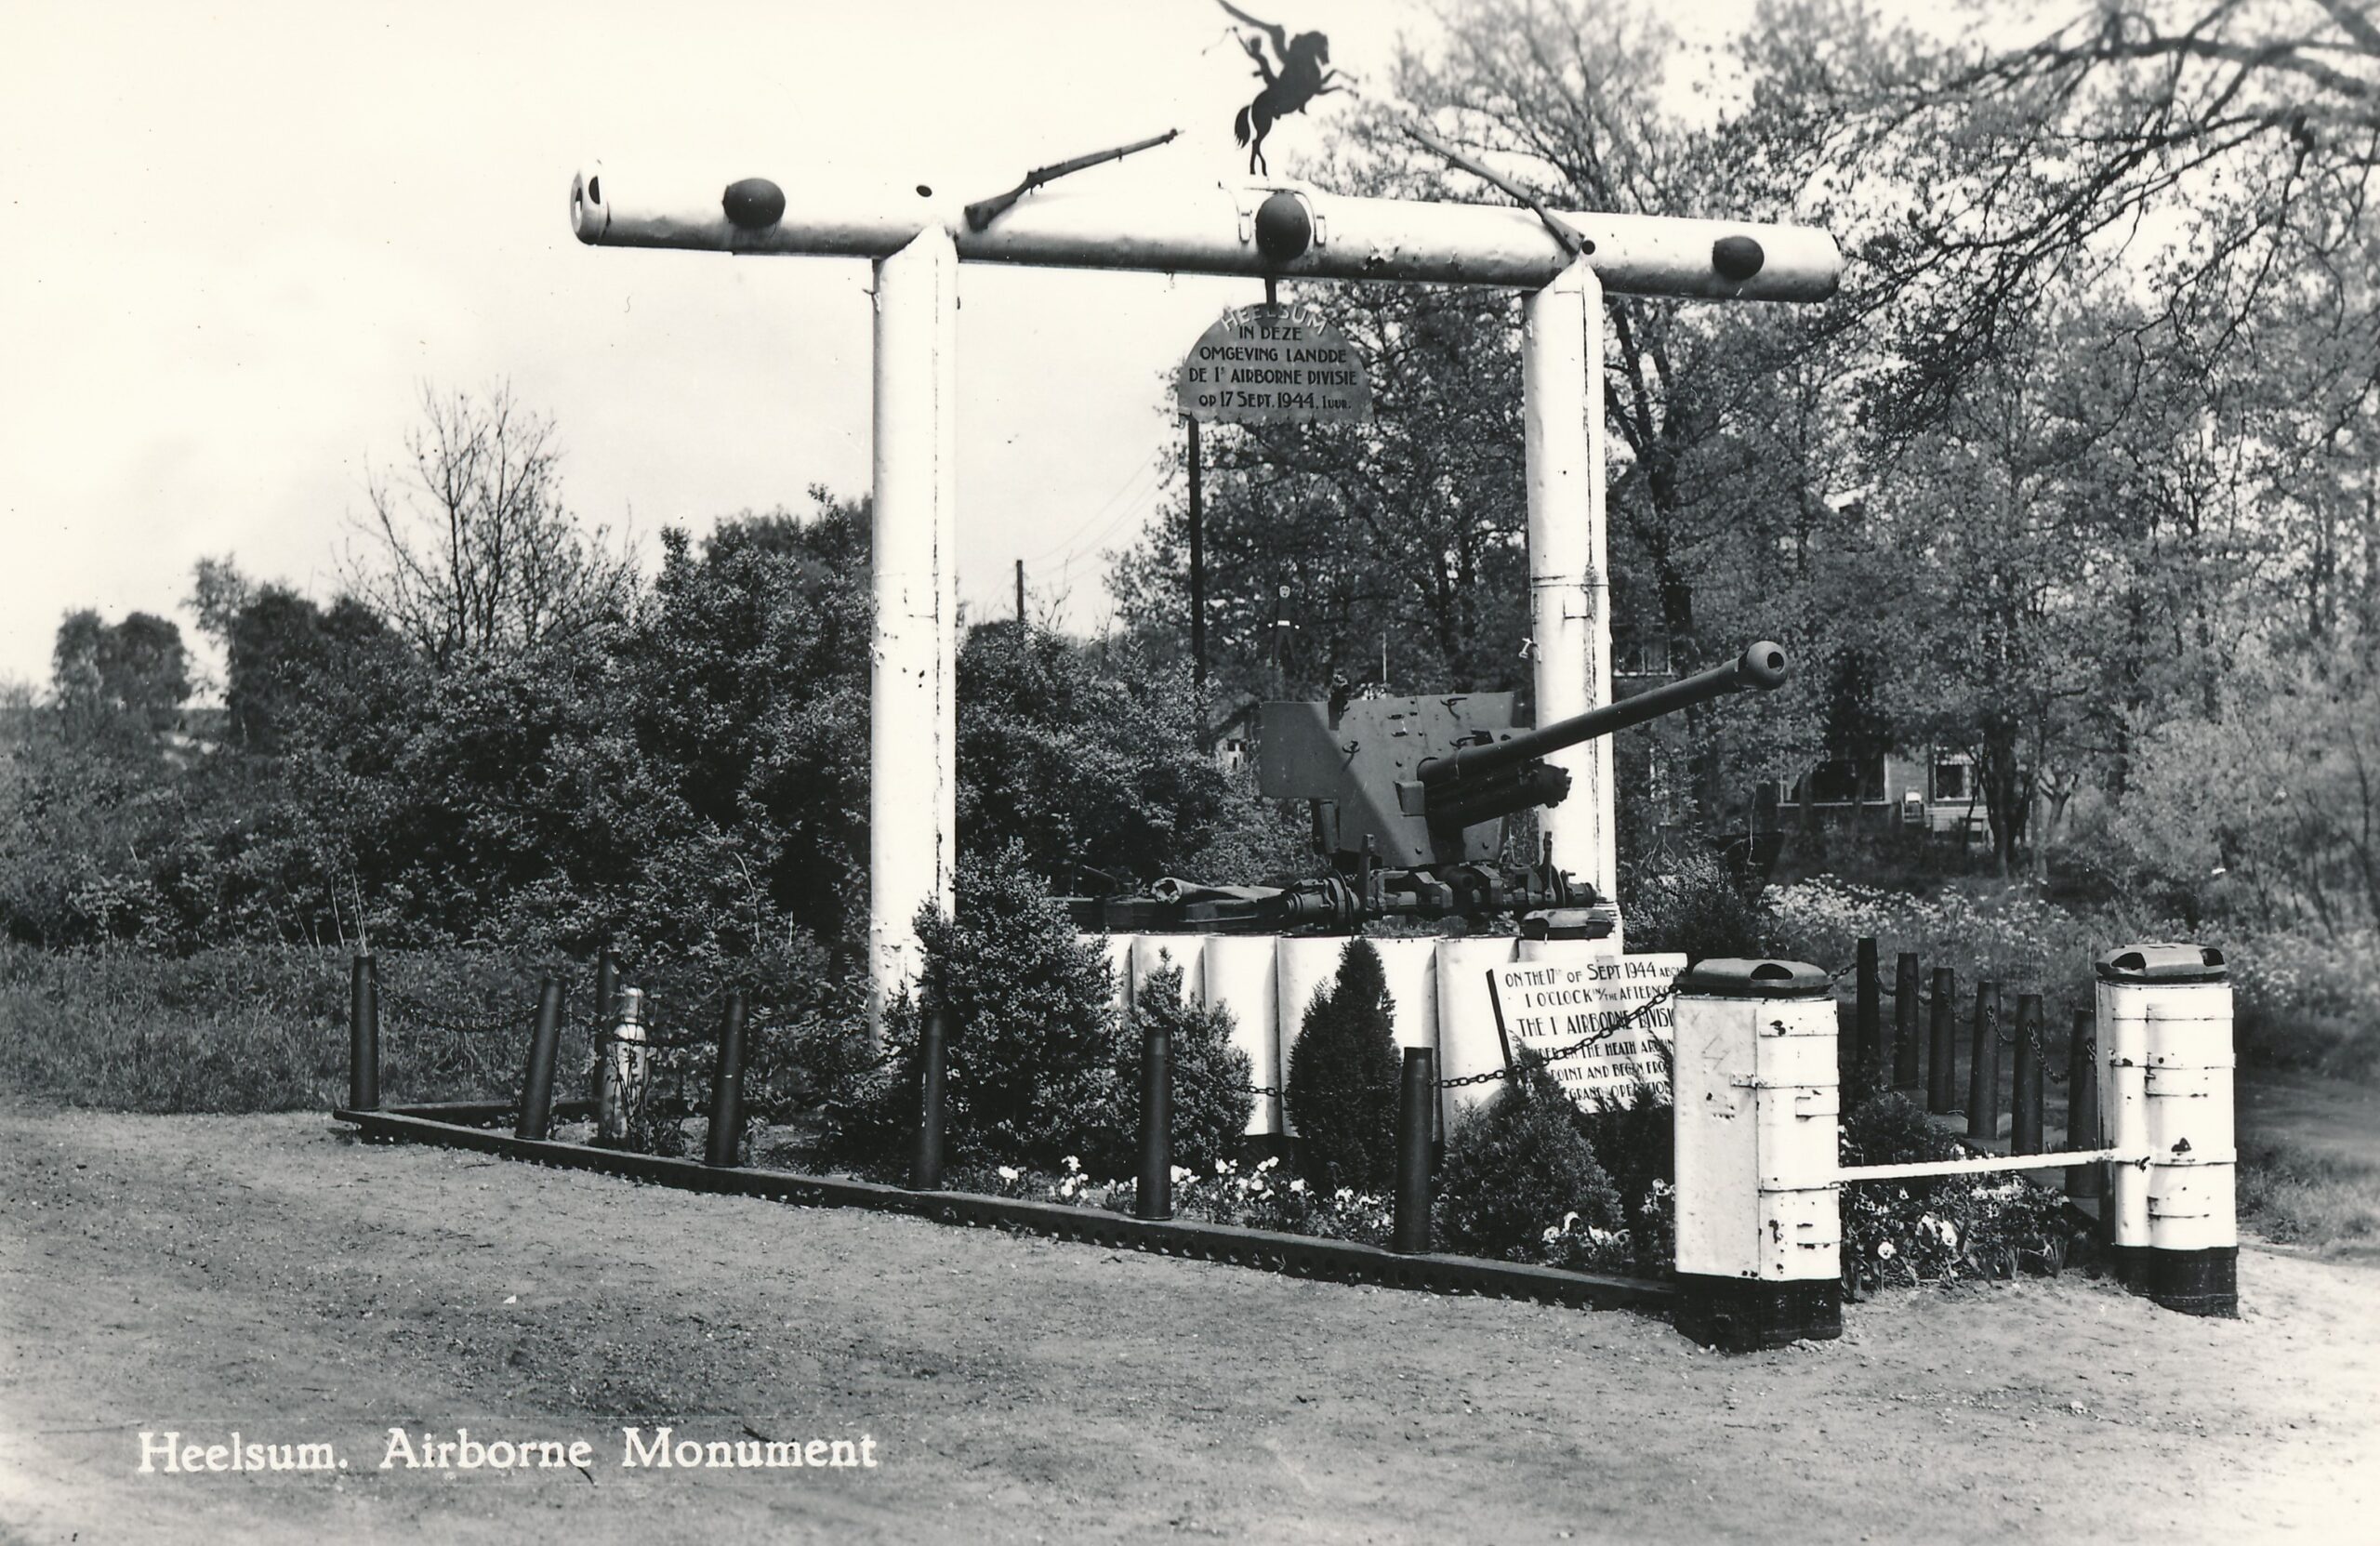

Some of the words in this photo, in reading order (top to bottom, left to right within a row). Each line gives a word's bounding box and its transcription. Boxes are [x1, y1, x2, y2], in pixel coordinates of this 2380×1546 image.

[1221, 304, 1328, 336] HEELSUM
[1239, 325, 1254, 339] IN
[1261, 326, 1302, 341] DEZE
[1199, 347, 1278, 362] OMGEVING
[1189, 368, 1207, 382] DE
[1231, 369, 1302, 385] AIRBORNE
[1308, 370, 1357, 386] DIVISIE
[1221, 391, 1234, 407] 17
[1505, 973, 1523, 987] ON
[1525, 971, 1545, 986] THE
[1567, 971, 1582, 983] OF
[1625, 961, 1657, 979] 1944
[1517, 1018, 1547, 1037] THE
[1581, 1043, 1602, 1059] THE
[1606, 1041, 1637, 1057] HEATH
[1587, 1064, 1610, 1080] AND
